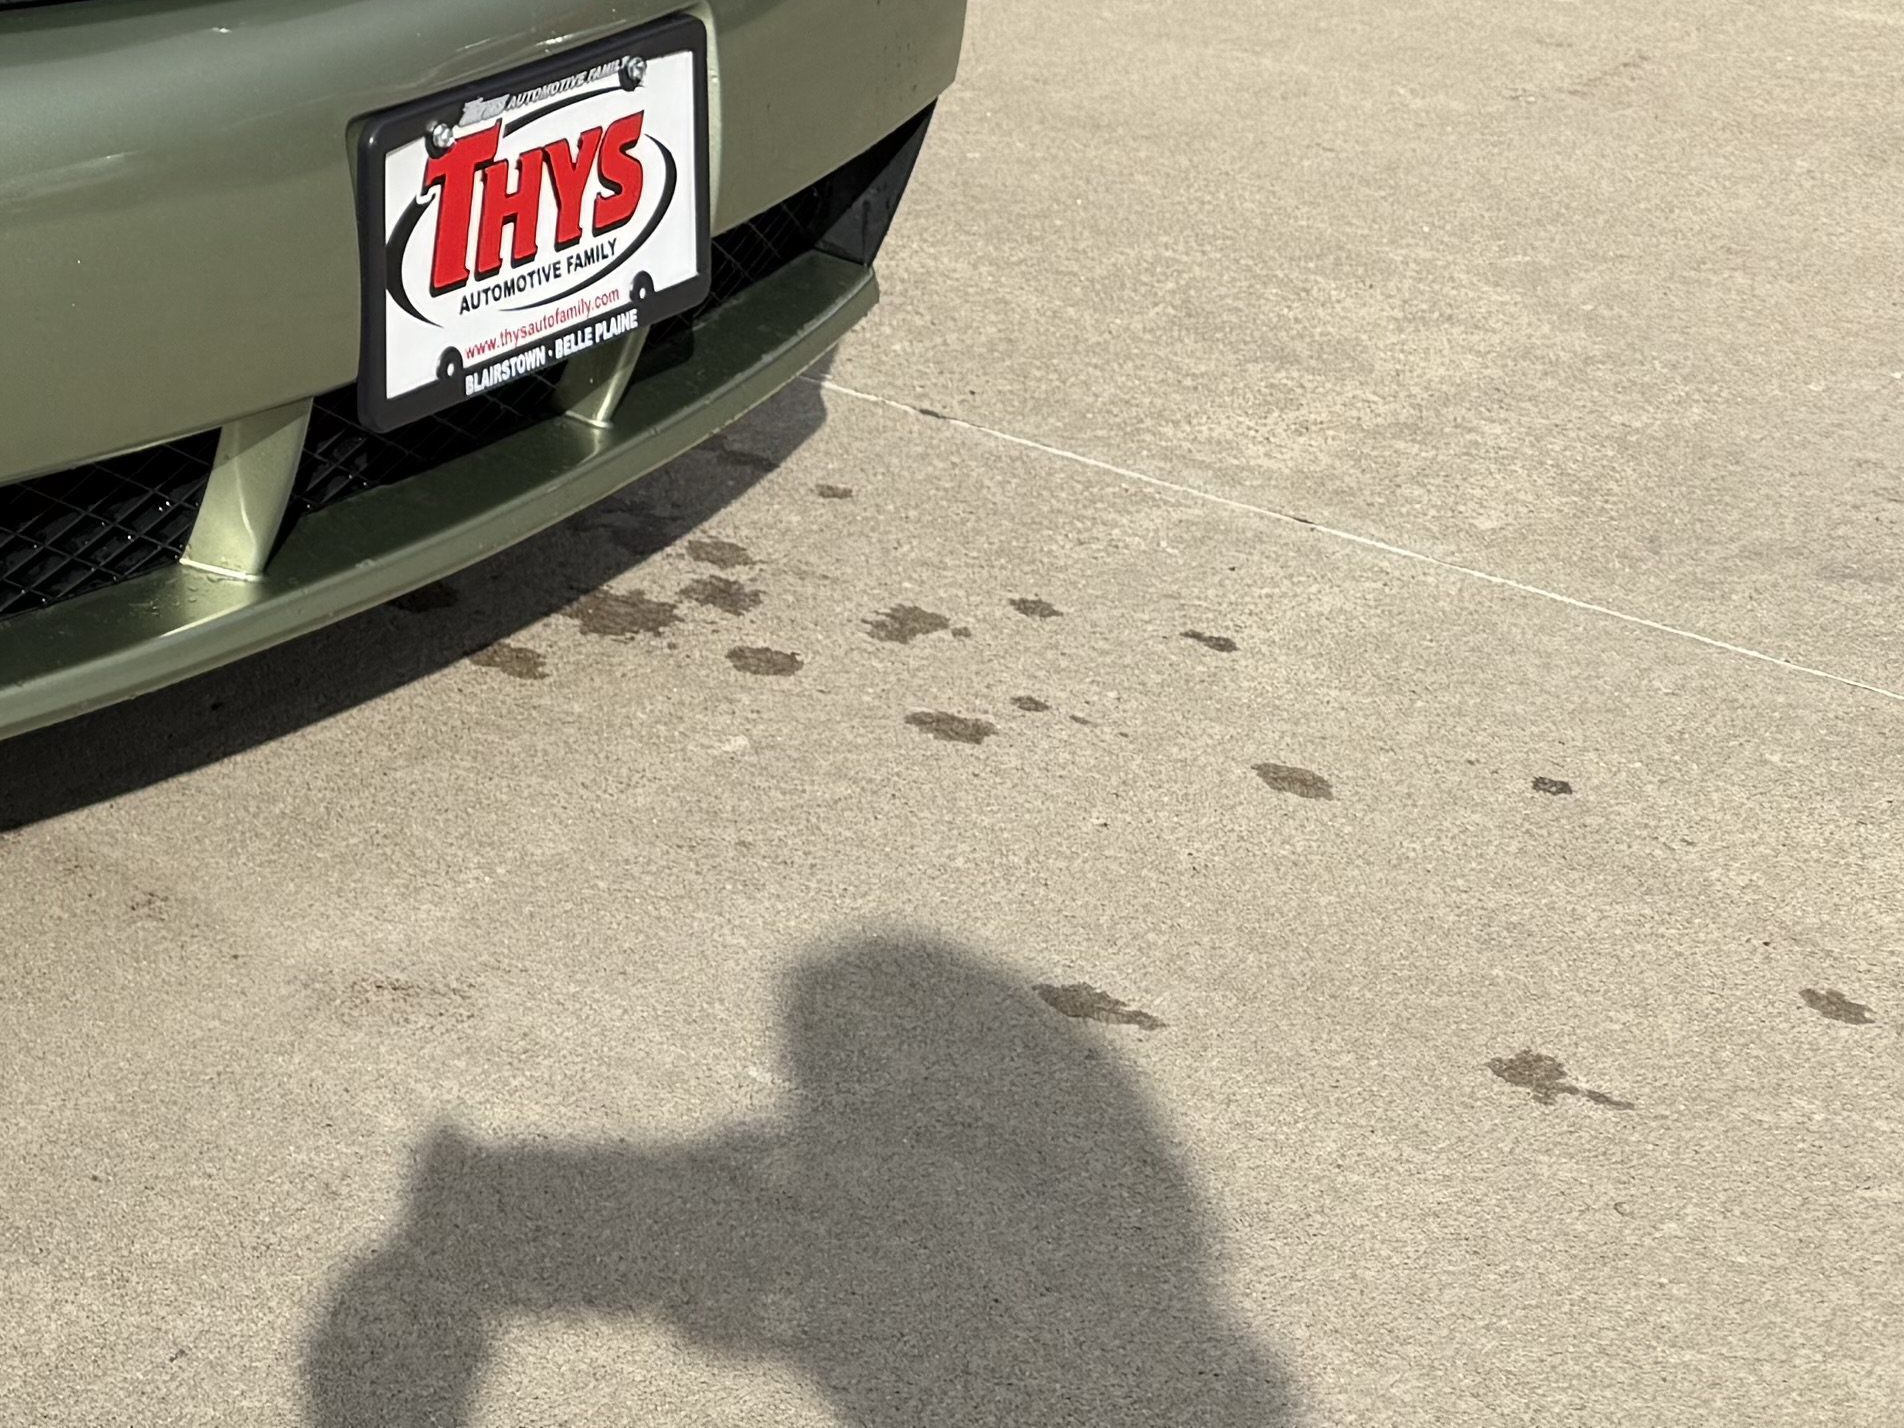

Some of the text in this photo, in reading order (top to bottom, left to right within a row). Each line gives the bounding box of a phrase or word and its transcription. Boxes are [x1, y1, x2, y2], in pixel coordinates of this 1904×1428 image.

[506, 70, 586, 111] AUTOMOTIVE
[422, 109, 645, 296] THYS
[459, 237, 618, 315] AUTOMOTIVE FAMILY
[464, 287, 620, 360] www.thysautofamily.com
[465, 308, 639, 396] BLAIRSTOWN BELLE PLAINE
